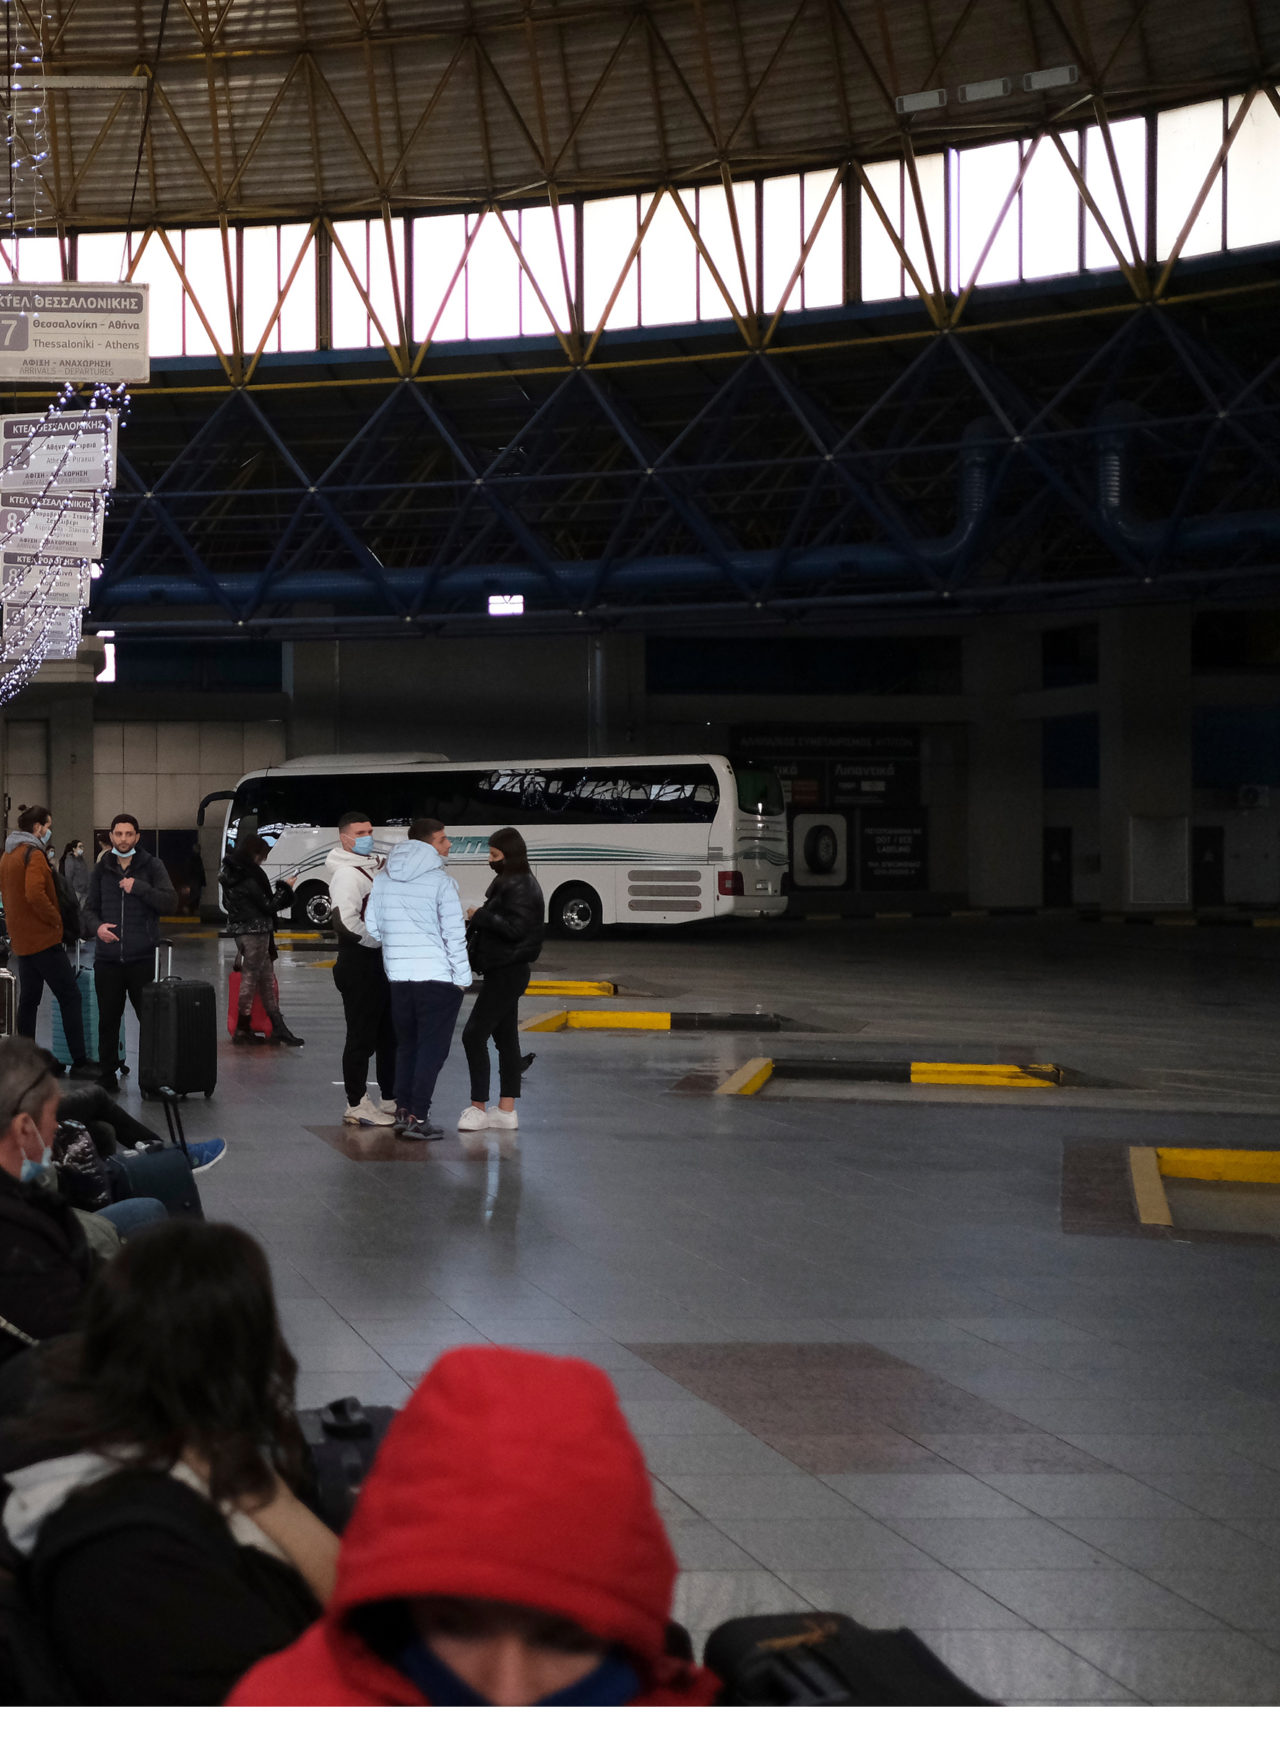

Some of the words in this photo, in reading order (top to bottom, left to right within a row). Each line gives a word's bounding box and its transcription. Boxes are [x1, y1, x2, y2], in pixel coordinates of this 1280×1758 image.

[34, 296, 139, 310] ΘΕΣΣΑΛΟΝΙΚΗΣ
[32, 319, 98, 330] Θεσσαλονίκη
[107, 320, 140, 330] Αθήνα
[0, 319, 18, 346] 7
[32, 338, 95, 349] Thessaloniki
[105, 340, 140, 350] Athens
[22, 359, 51, 367] ΑΦΙΞΗ
[58, 359, 112, 368] ΑΝΑΧΩΡΗΣΗ
[19, 367, 57, 375] ARRIVALS
[64, 367, 114, 376] DEPARTURES
[9, 496, 29, 504] ΚΤΕΛ
